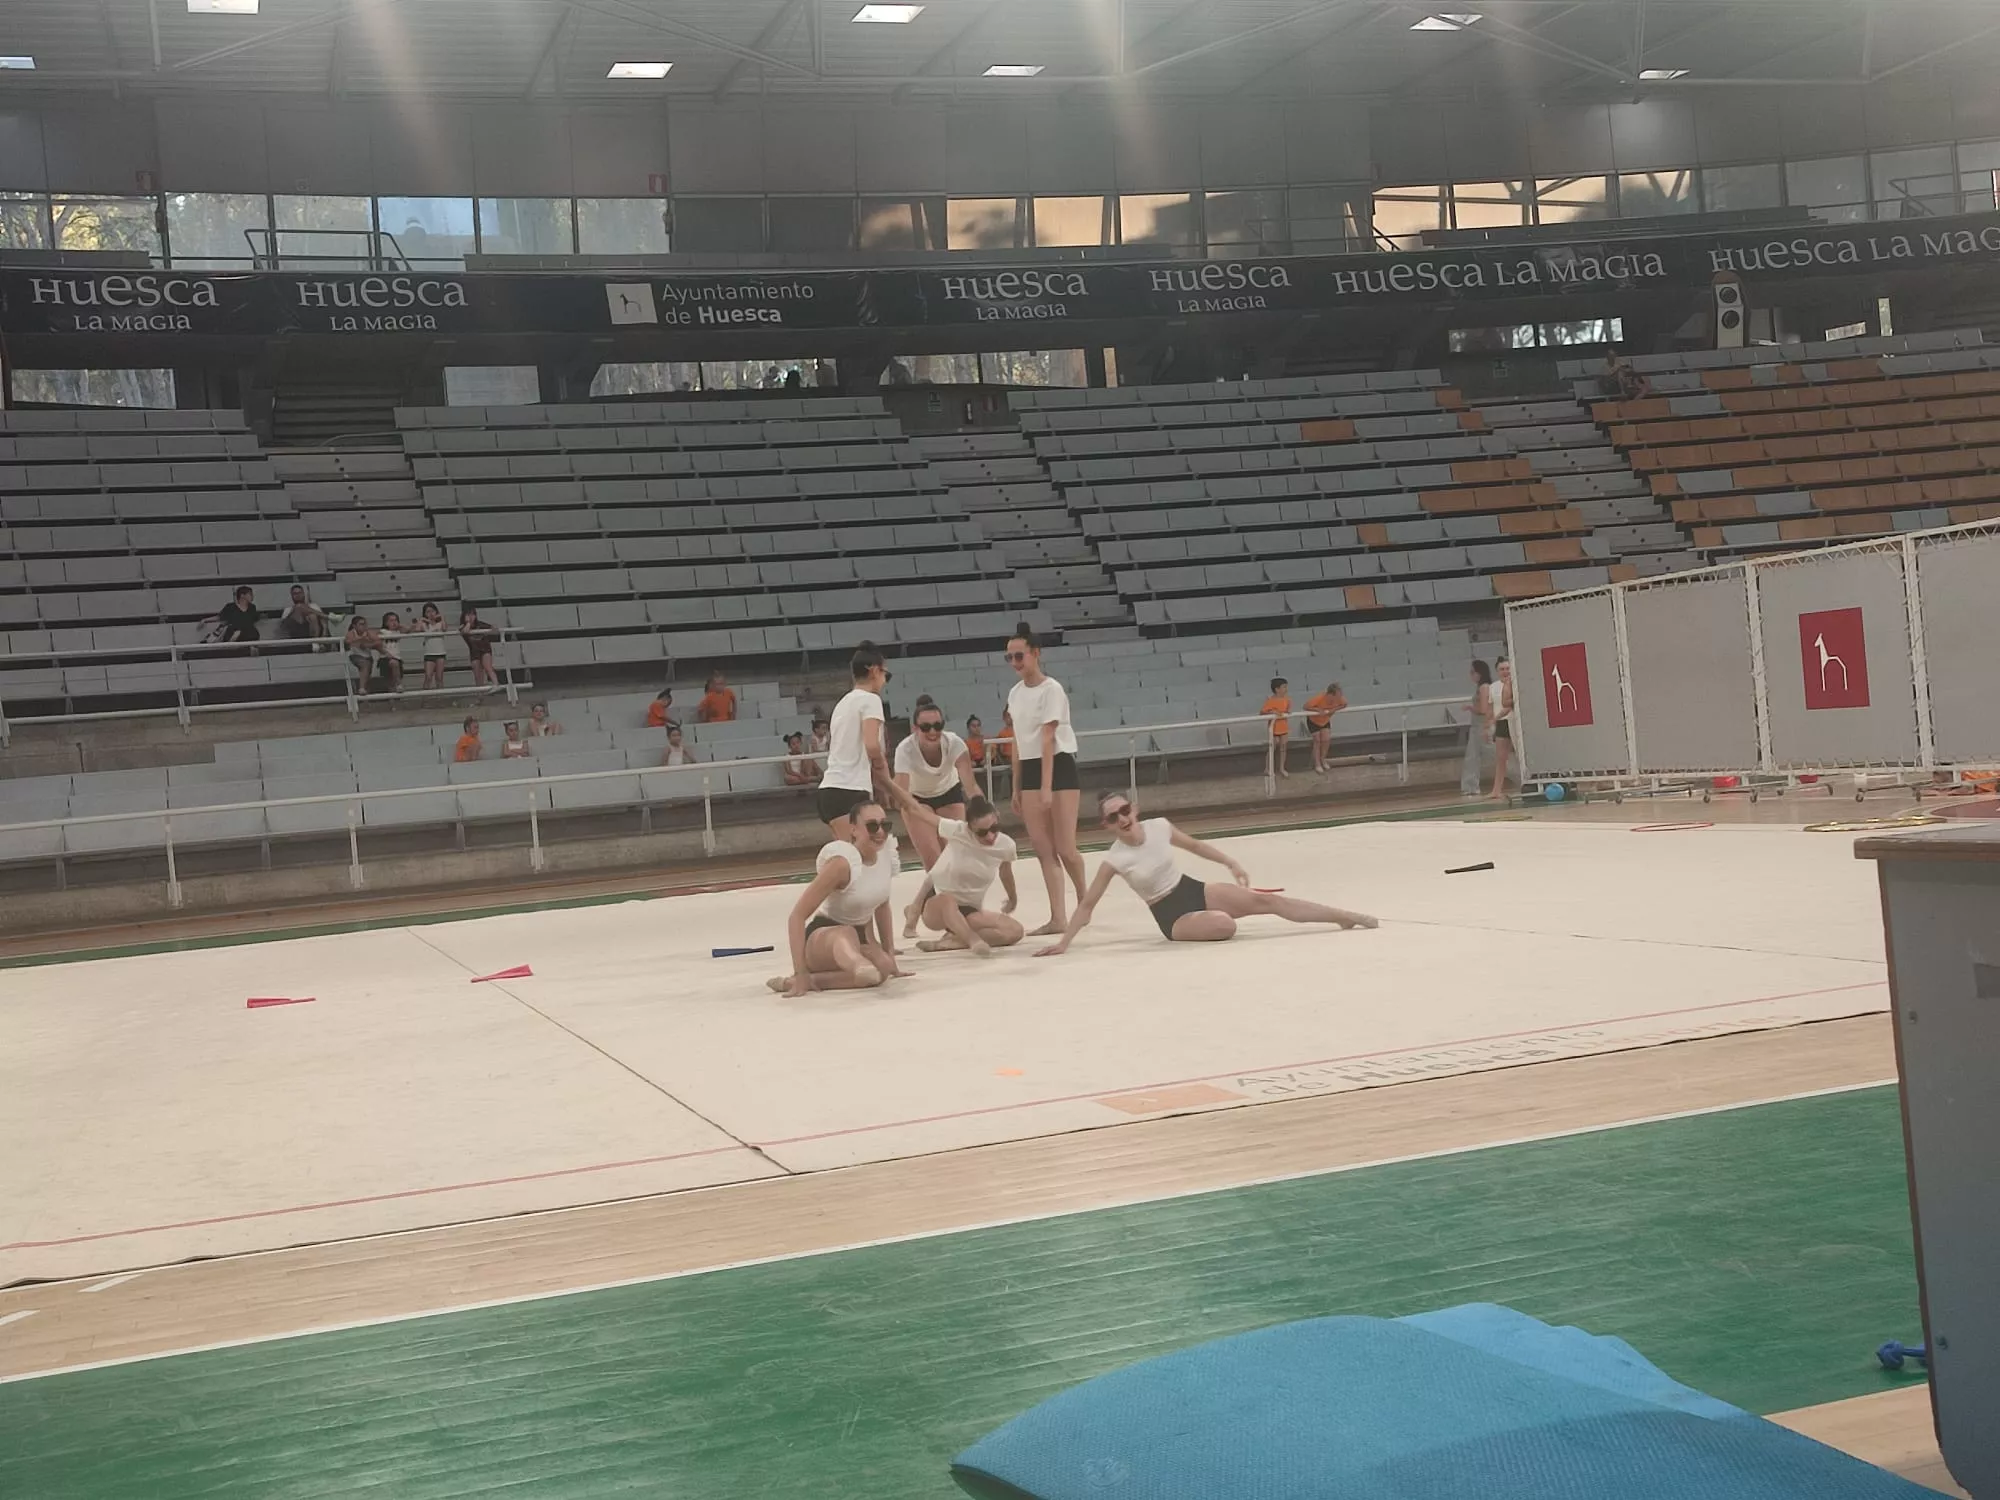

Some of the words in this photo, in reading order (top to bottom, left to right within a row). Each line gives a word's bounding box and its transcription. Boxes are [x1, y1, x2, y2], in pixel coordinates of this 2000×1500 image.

[1708, 238, 1862, 272] Huesca
[1868, 235, 1914, 261] La
[29, 273, 220, 306] Huesca
[296, 275, 468, 307] Huesca
[941, 270, 1089, 300] Huesca
[1149, 263, 1292, 293] Huesca
[1332, 261, 1487, 295] Huesca
[1494, 258, 1540, 286] La
[661, 281, 814, 305] Ayuntamiento
[1178, 299, 1200, 313] La
[74, 314, 103, 331] La
[330, 315, 358, 331] La
[665, 306, 692, 325] de
[699, 305, 782, 324] Huesca
[976, 306, 999, 321] La
[1339, 1049, 1556, 1084] Huesca
